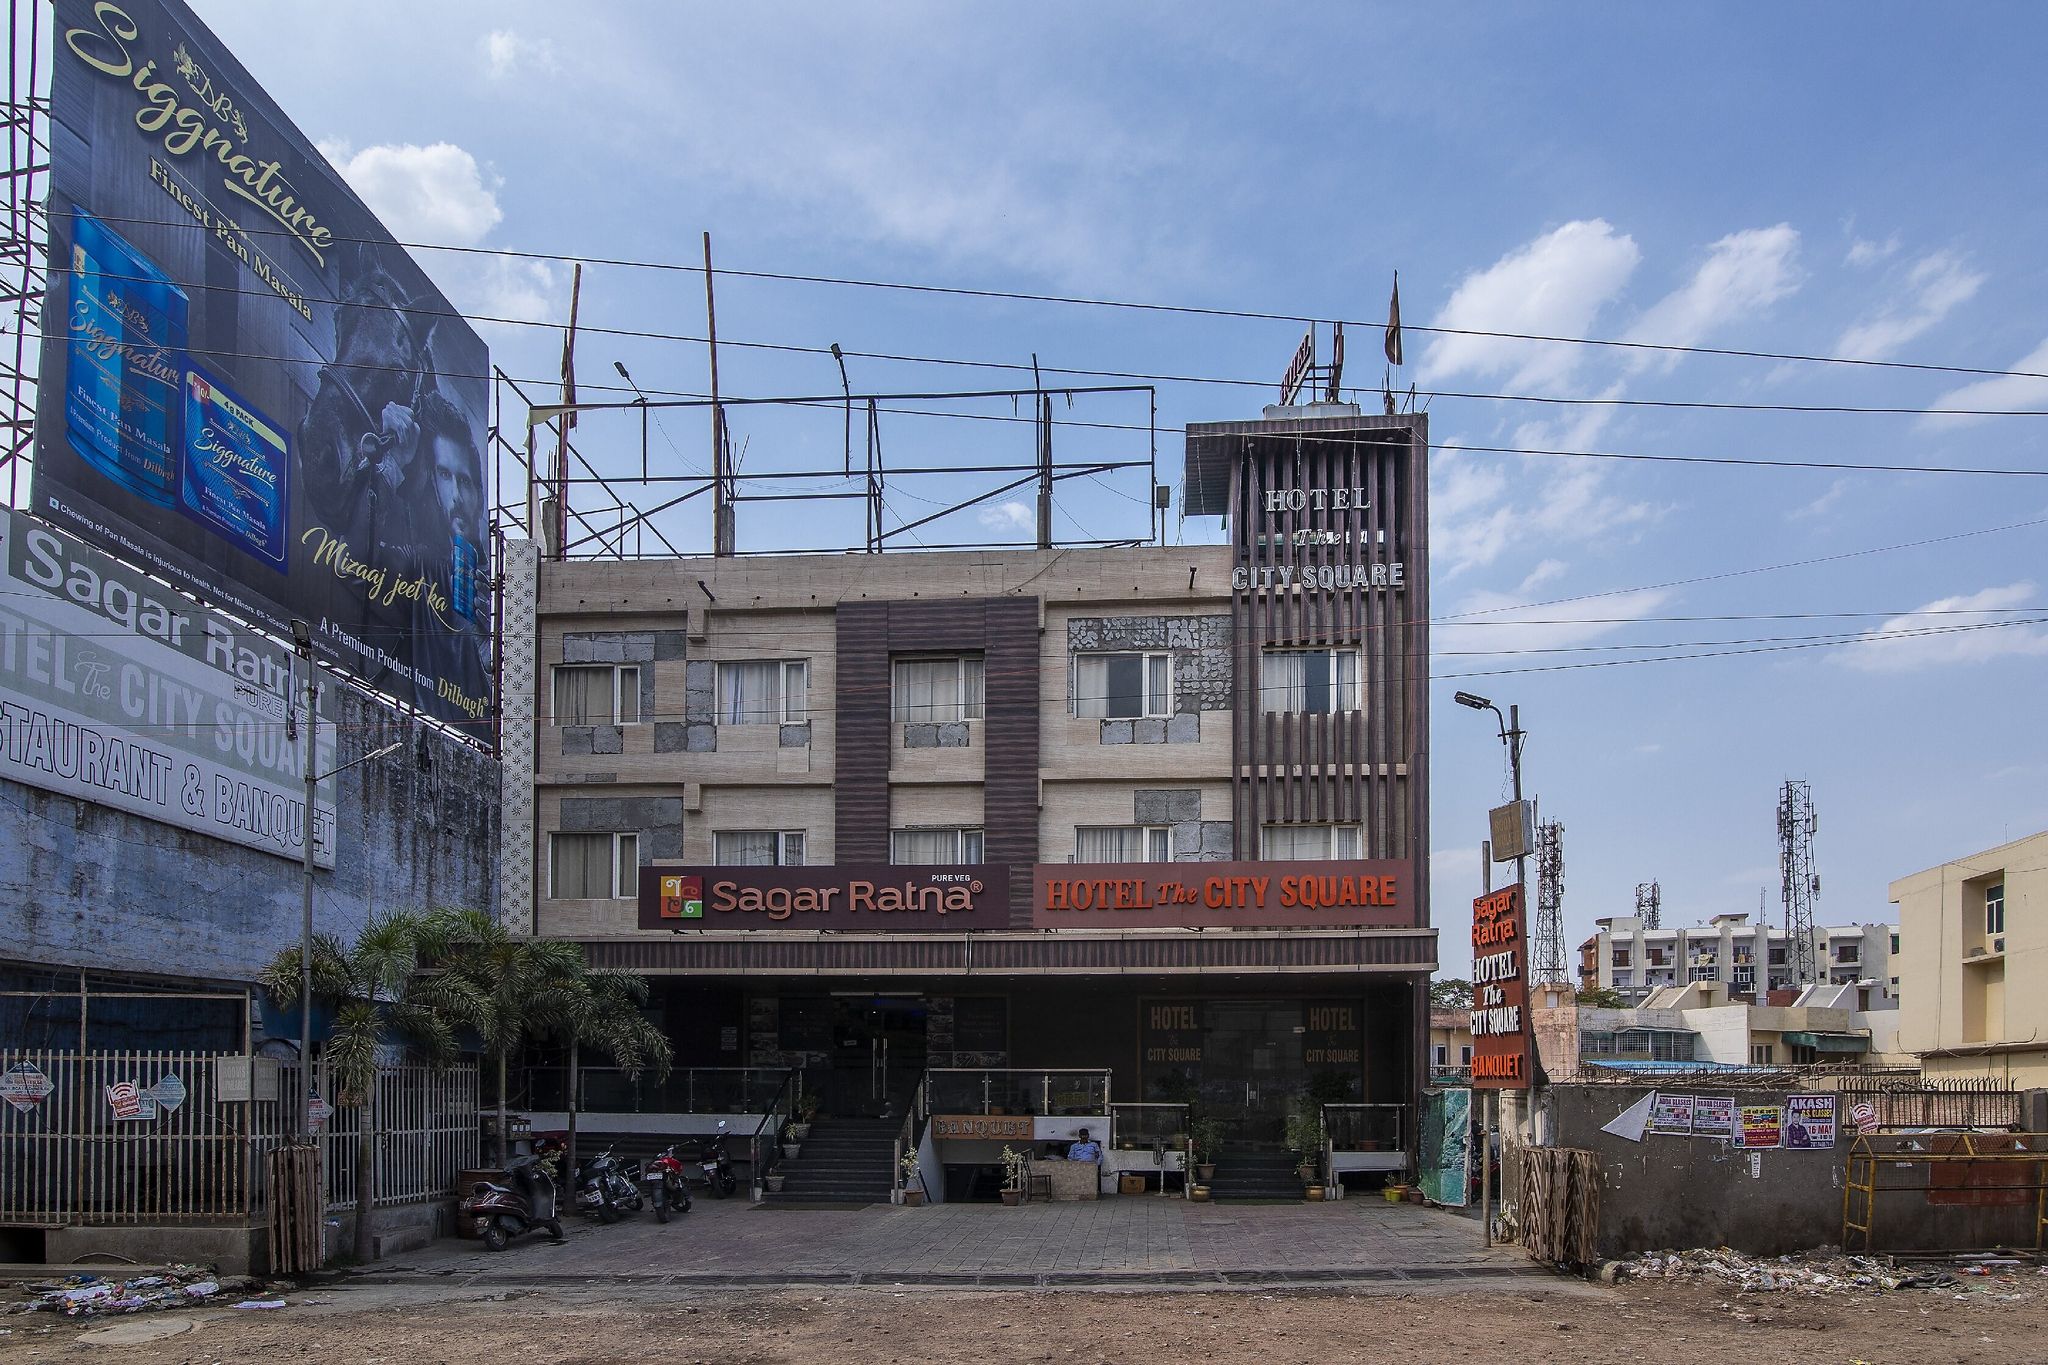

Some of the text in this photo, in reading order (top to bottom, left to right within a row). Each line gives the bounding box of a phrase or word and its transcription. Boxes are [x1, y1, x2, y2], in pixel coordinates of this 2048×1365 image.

[66, 2, 334, 250] Siggnature
[150, 157, 312, 321] Finest Pan Masala
[78, 386, 171, 453] Finest Pan Masala
[236, 409, 254, 427] PACK
[194, 428, 277, 483] Siggnature
[204, 486, 266, 530] Finest Pan Masala
[1266, 487, 1371, 512] HOTEL
[1297, 528, 1342, 547] The
[60, 504, 94, 529] Chewing
[95, 523, 103, 533] of
[104, 527, 118, 540] Pan
[120, 536, 144, 556] Masala
[145, 549, 152, 559] is
[153, 553, 181, 576] injurious
[183, 570, 190, 580] to
[191, 574, 212, 592] health.
[212, 586, 224, 598] Not
[225, 592, 234, 603] for
[234, 597, 255, 614] Minors.
[266, 613, 288, 632] Tobacco
[302, 527, 387, 600] Mizaaj
[383, 573, 428, 606] jeet
[1232, 563, 1404, 591] CITY SQUARE
[25, 529, 189, 646] Sagar
[320, 616, 328, 635] A
[332, 622, 375, 660] Premium
[377, 649, 412, 680] Product
[415, 668, 434, 691] from
[74, 651, 111, 700] The
[120, 663, 204, 739] CITY
[233, 680, 282, 719] PURE
[0, 700, 172, 806] TAURANT
[181, 764, 204, 818] &
[931, 874, 971, 882] PURE VEG
[1046, 874, 1396, 911] HOTEL The CITY SQUARE
[712, 881, 840, 920] Sagar
[1473, 891, 1513, 921] Sagar
[1472, 919, 1515, 948] Ratna
[1471, 951, 1517, 986] HOTEL
[1482, 984, 1502, 1006] The
[1151, 1006, 1198, 1030] HOTEL
[1310, 1007, 1355, 1031] HOTEL
[1470, 1006, 1519, 1036] CITY SQUARE
[1147, 1047, 1201, 1063] CITY SQUARE
[1306, 1049, 1359, 1064] CITY SQUARE
[1471, 1054, 1520, 1077] BANQUET
[1790, 1098, 1833, 1110] AKASH
[1811, 1109, 1833, 1118] CLASSES
[935, 1119, 1030, 1138] BANQUET
[1808, 1125, 1833, 1135] 16 MAY
